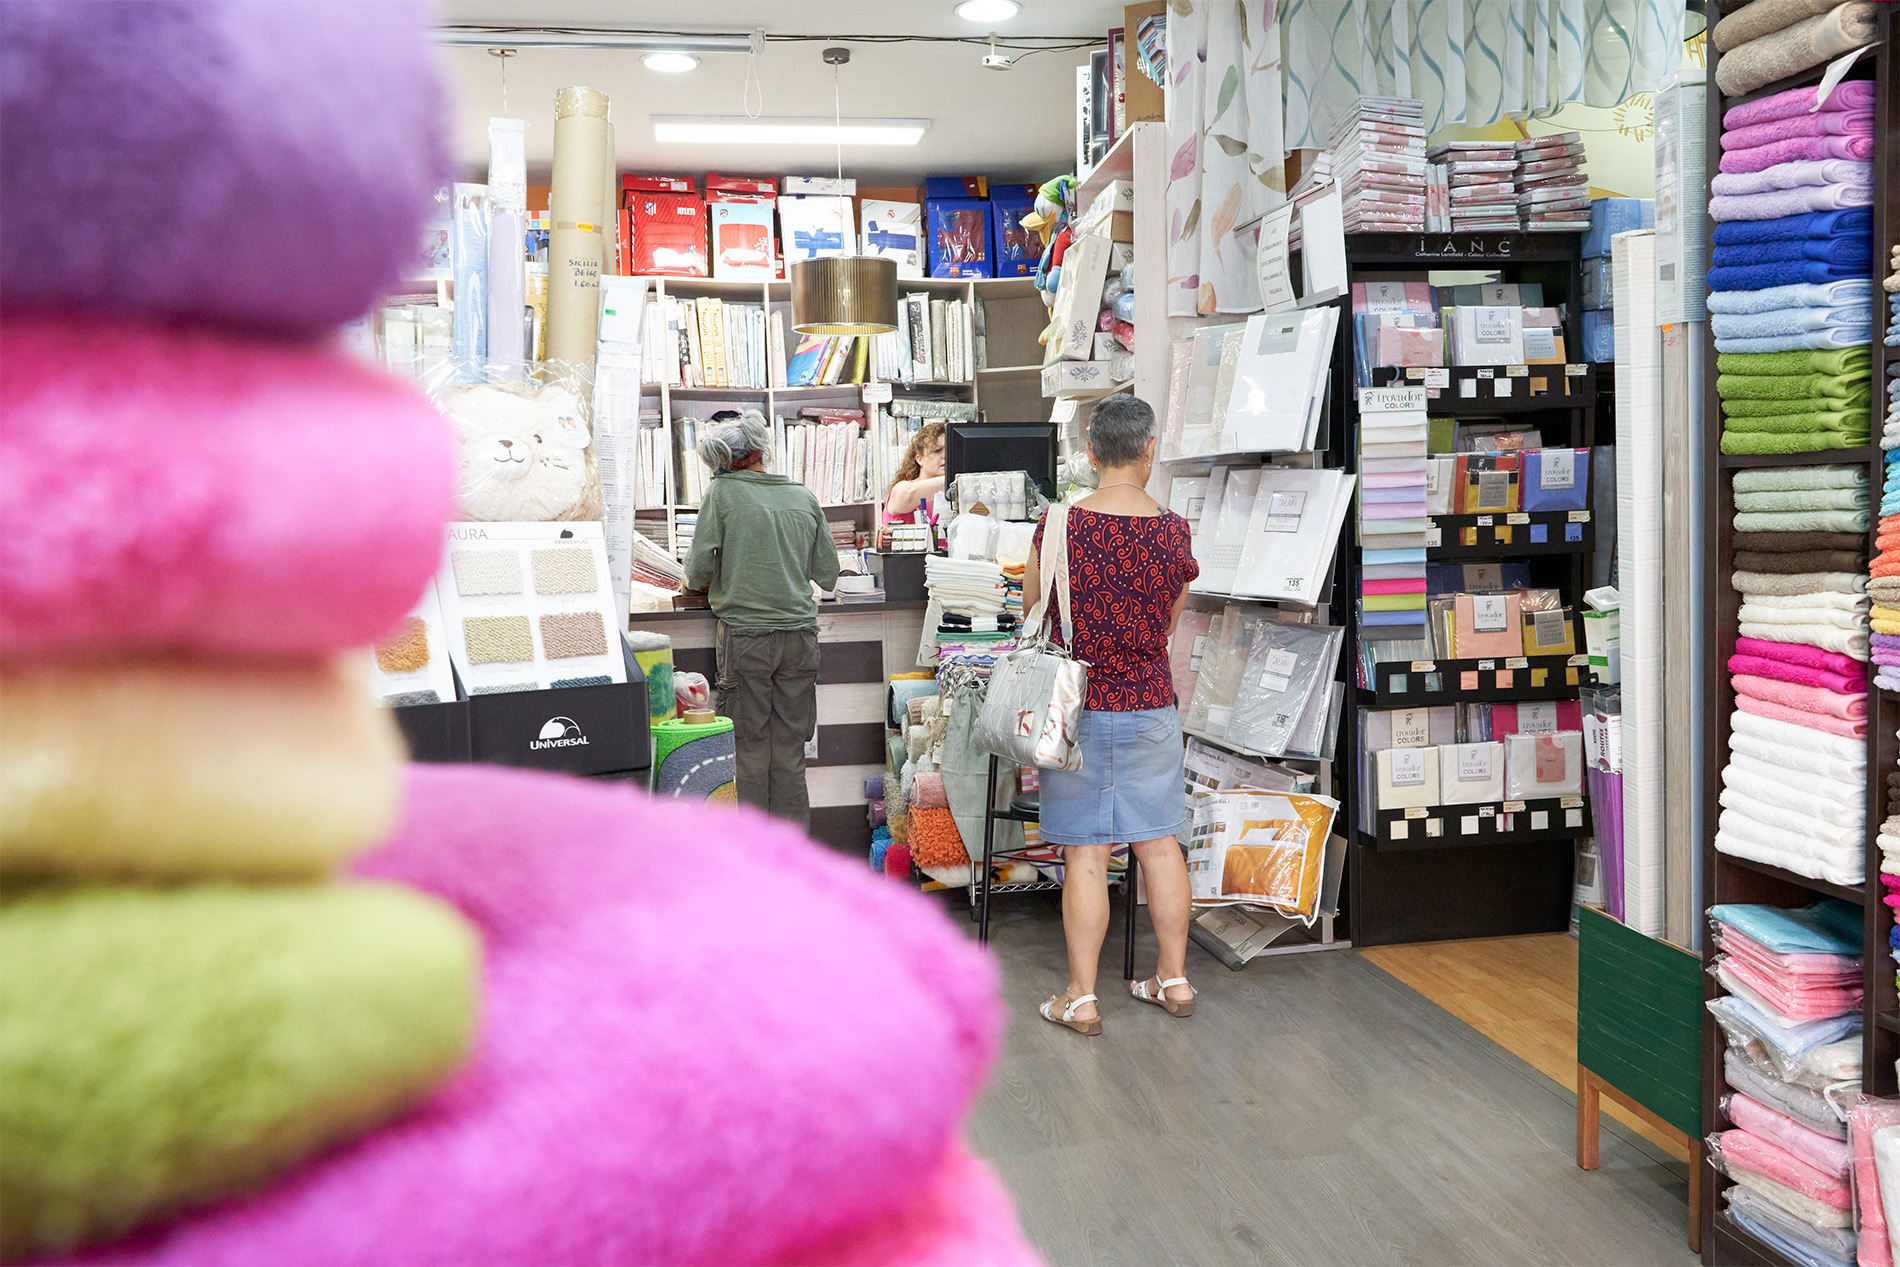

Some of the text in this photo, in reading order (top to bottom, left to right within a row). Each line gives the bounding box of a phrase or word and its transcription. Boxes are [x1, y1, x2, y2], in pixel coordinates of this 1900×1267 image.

[677, 207, 695, 215] ATLETI
[1377, 391, 1422, 402] trovador
[1545, 468, 1571, 476] trovador
[1478, 611, 1503, 619] trovador
[1523, 720, 1553, 729] trovador
[1396, 728, 1426, 737] trovador
[530, 736, 590, 750] UNIVERSAL
[1397, 736, 1425, 744] COLORS
[1396, 764, 1421, 772] trovador
[1462, 760, 1487, 768] trovador
